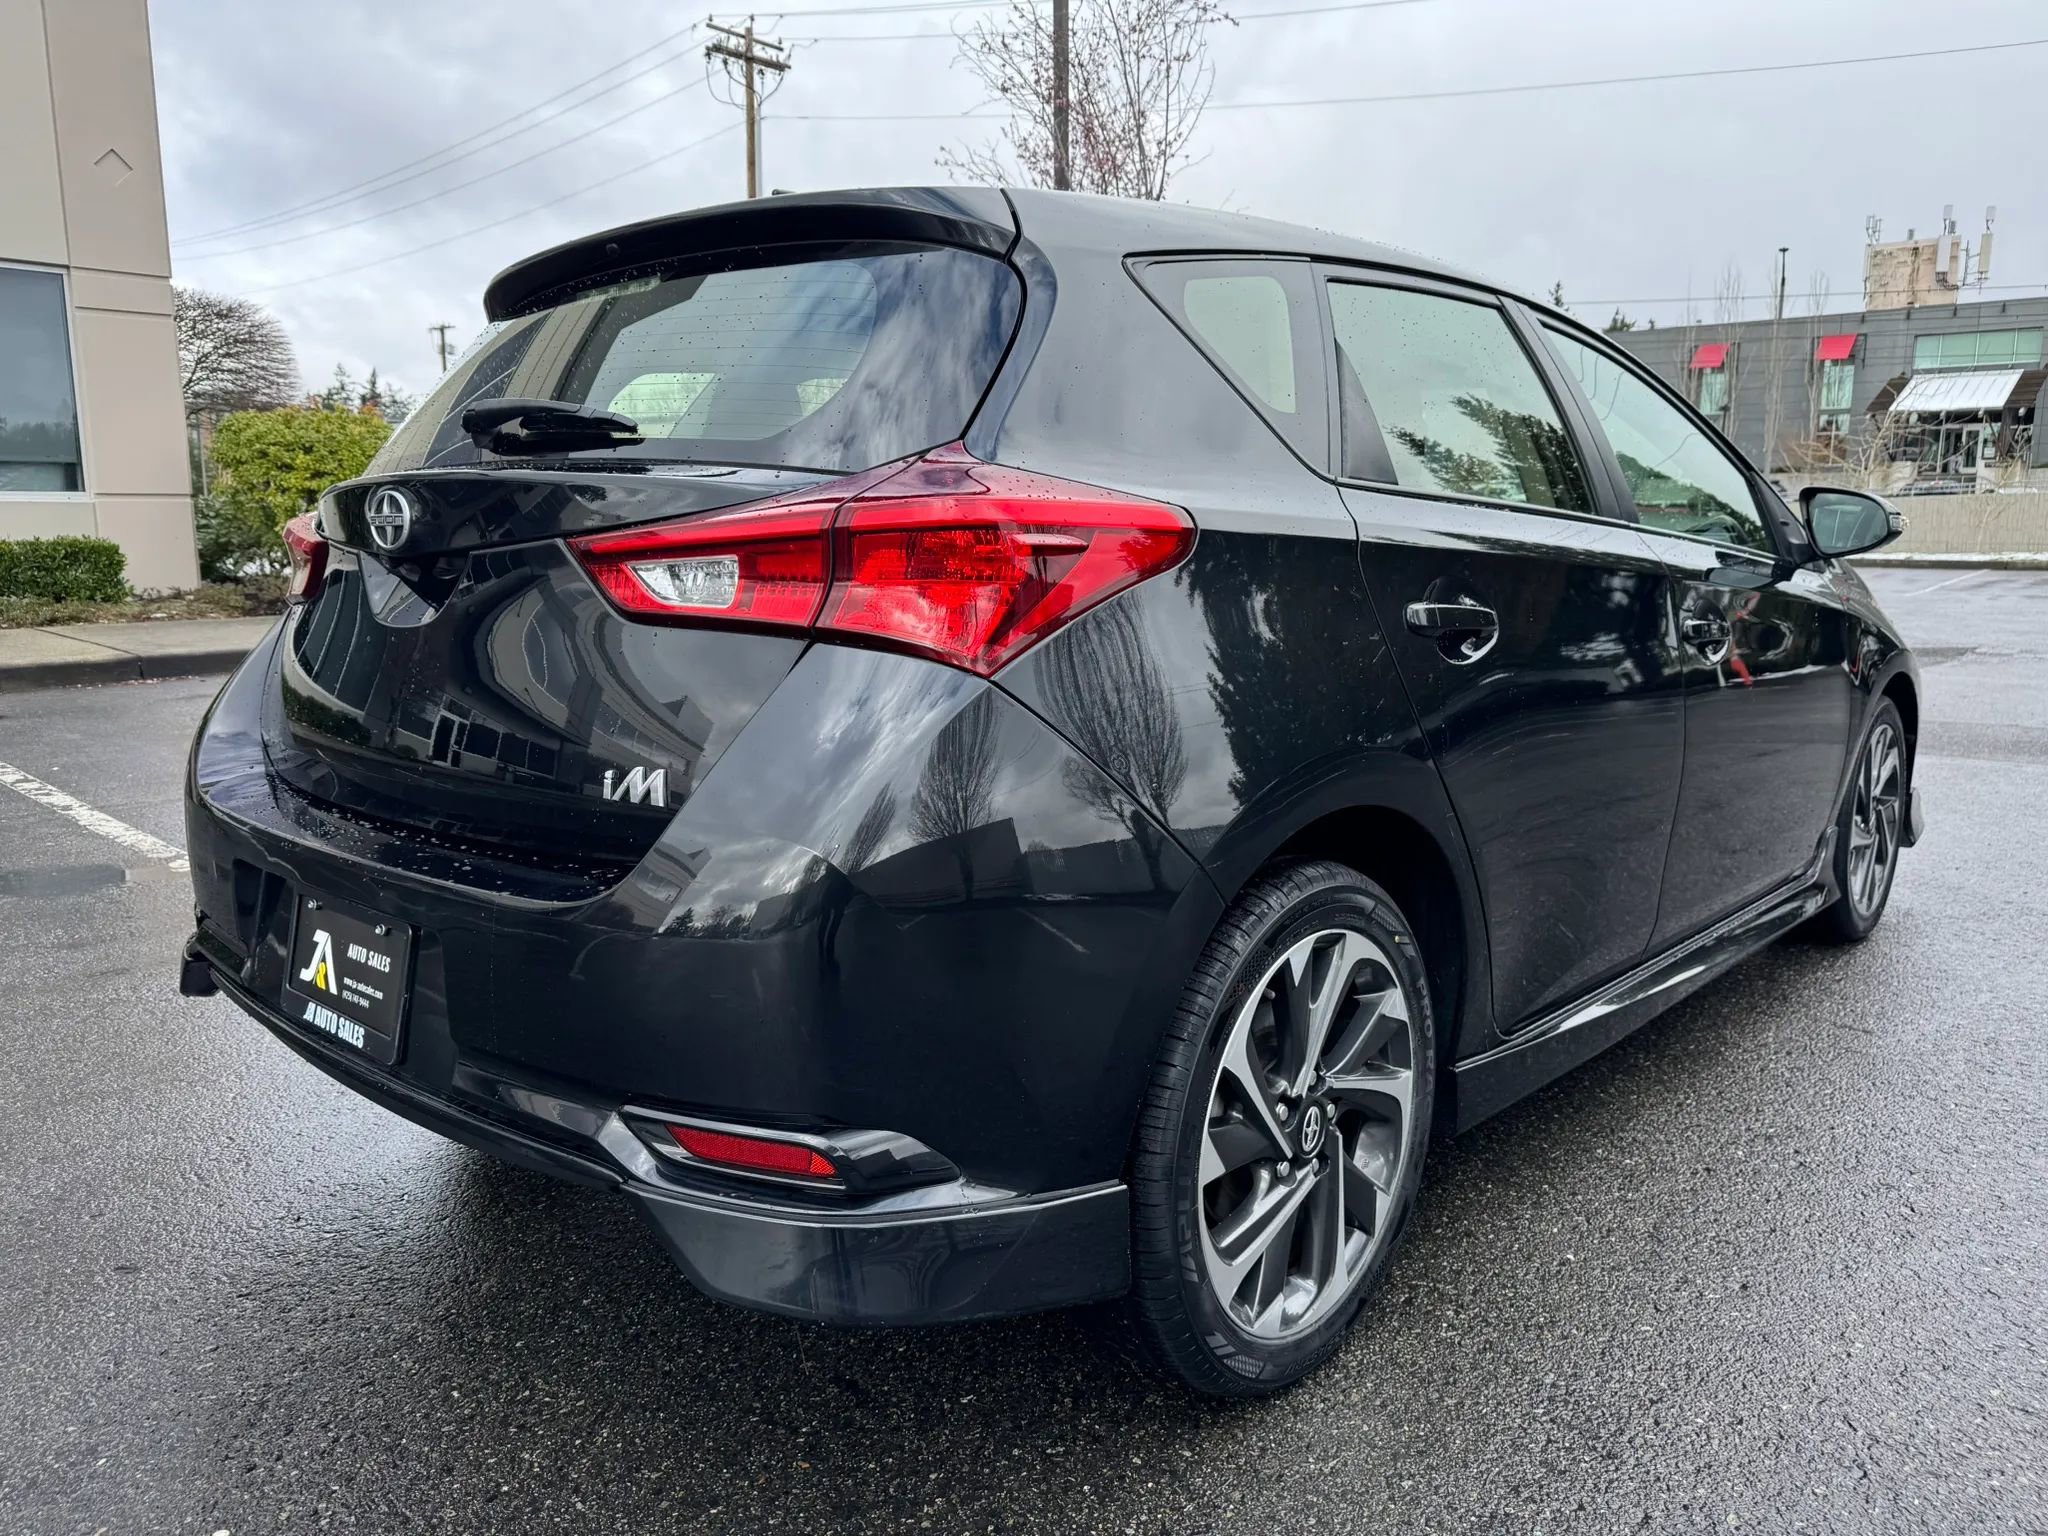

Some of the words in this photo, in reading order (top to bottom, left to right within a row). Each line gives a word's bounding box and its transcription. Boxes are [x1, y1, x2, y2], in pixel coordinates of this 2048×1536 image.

[603, 766, 667, 807] iM
[347, 943, 367, 963] AUTO
[367, 951, 391, 973] SALES
[314, 1005, 338, 1034] AUTO
[337, 1017, 365, 1049] SALES
